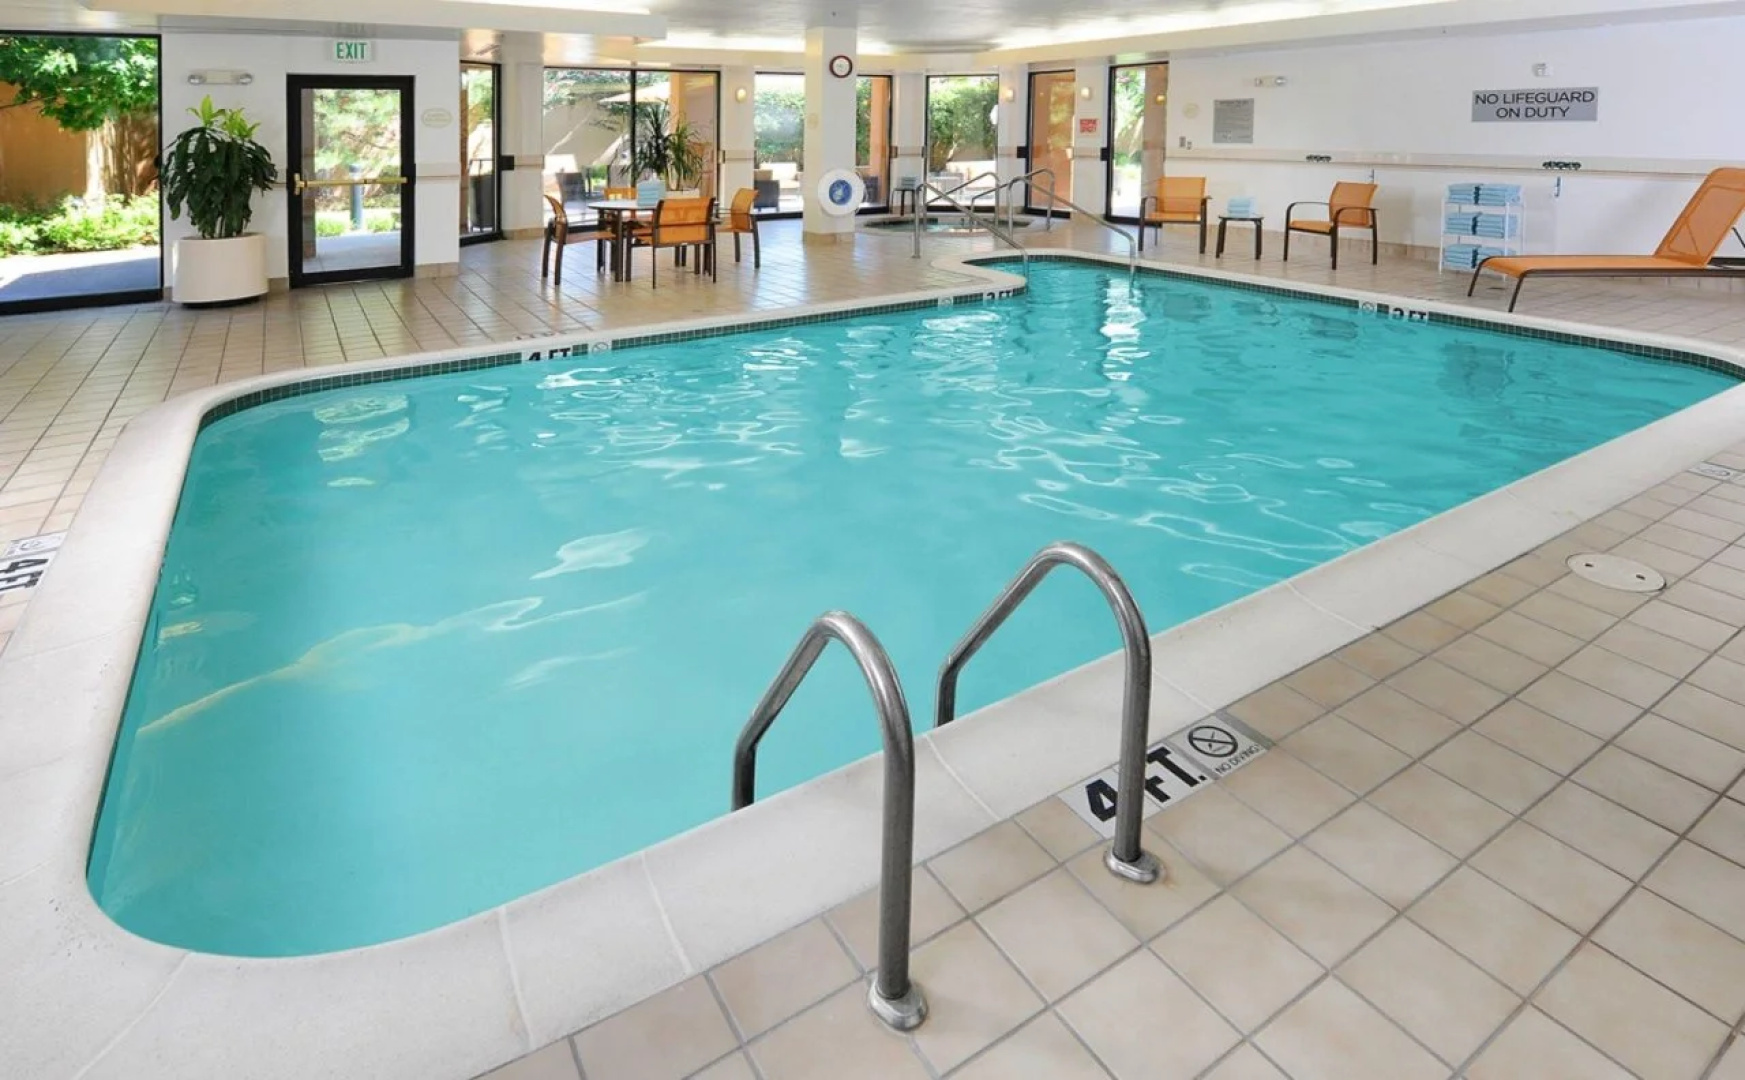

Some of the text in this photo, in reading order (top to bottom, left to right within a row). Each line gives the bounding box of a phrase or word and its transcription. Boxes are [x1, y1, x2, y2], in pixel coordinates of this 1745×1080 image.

[336, 42, 368, 59] EXIT
[1475, 91, 1595, 105] NO LIFEGUARD
[1496, 106, 1570, 119] ON DUTY
